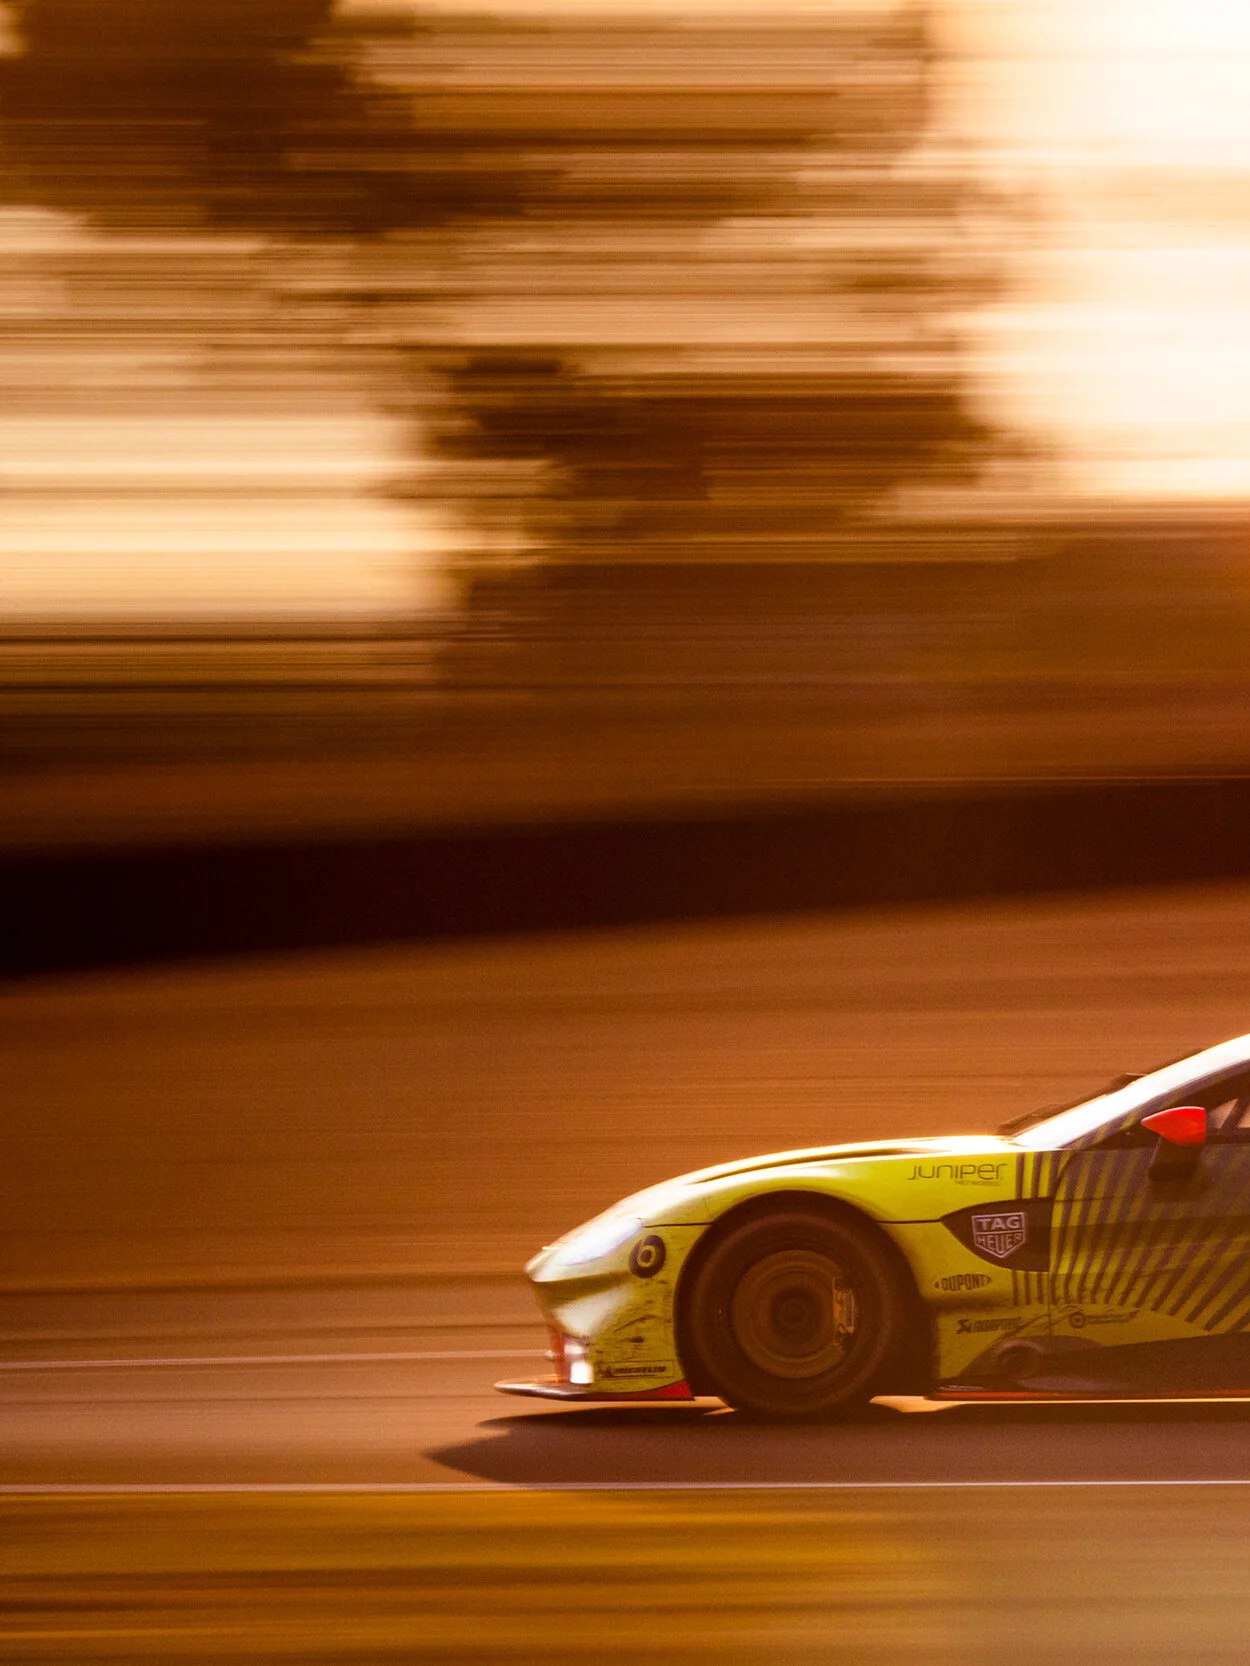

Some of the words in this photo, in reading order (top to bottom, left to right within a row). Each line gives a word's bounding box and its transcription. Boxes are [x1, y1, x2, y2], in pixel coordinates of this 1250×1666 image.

[976, 1216, 1021, 1231] TAG
[976, 1233, 1022, 1254] HEUER
[941, 1273, 986, 1292] DUPONT
